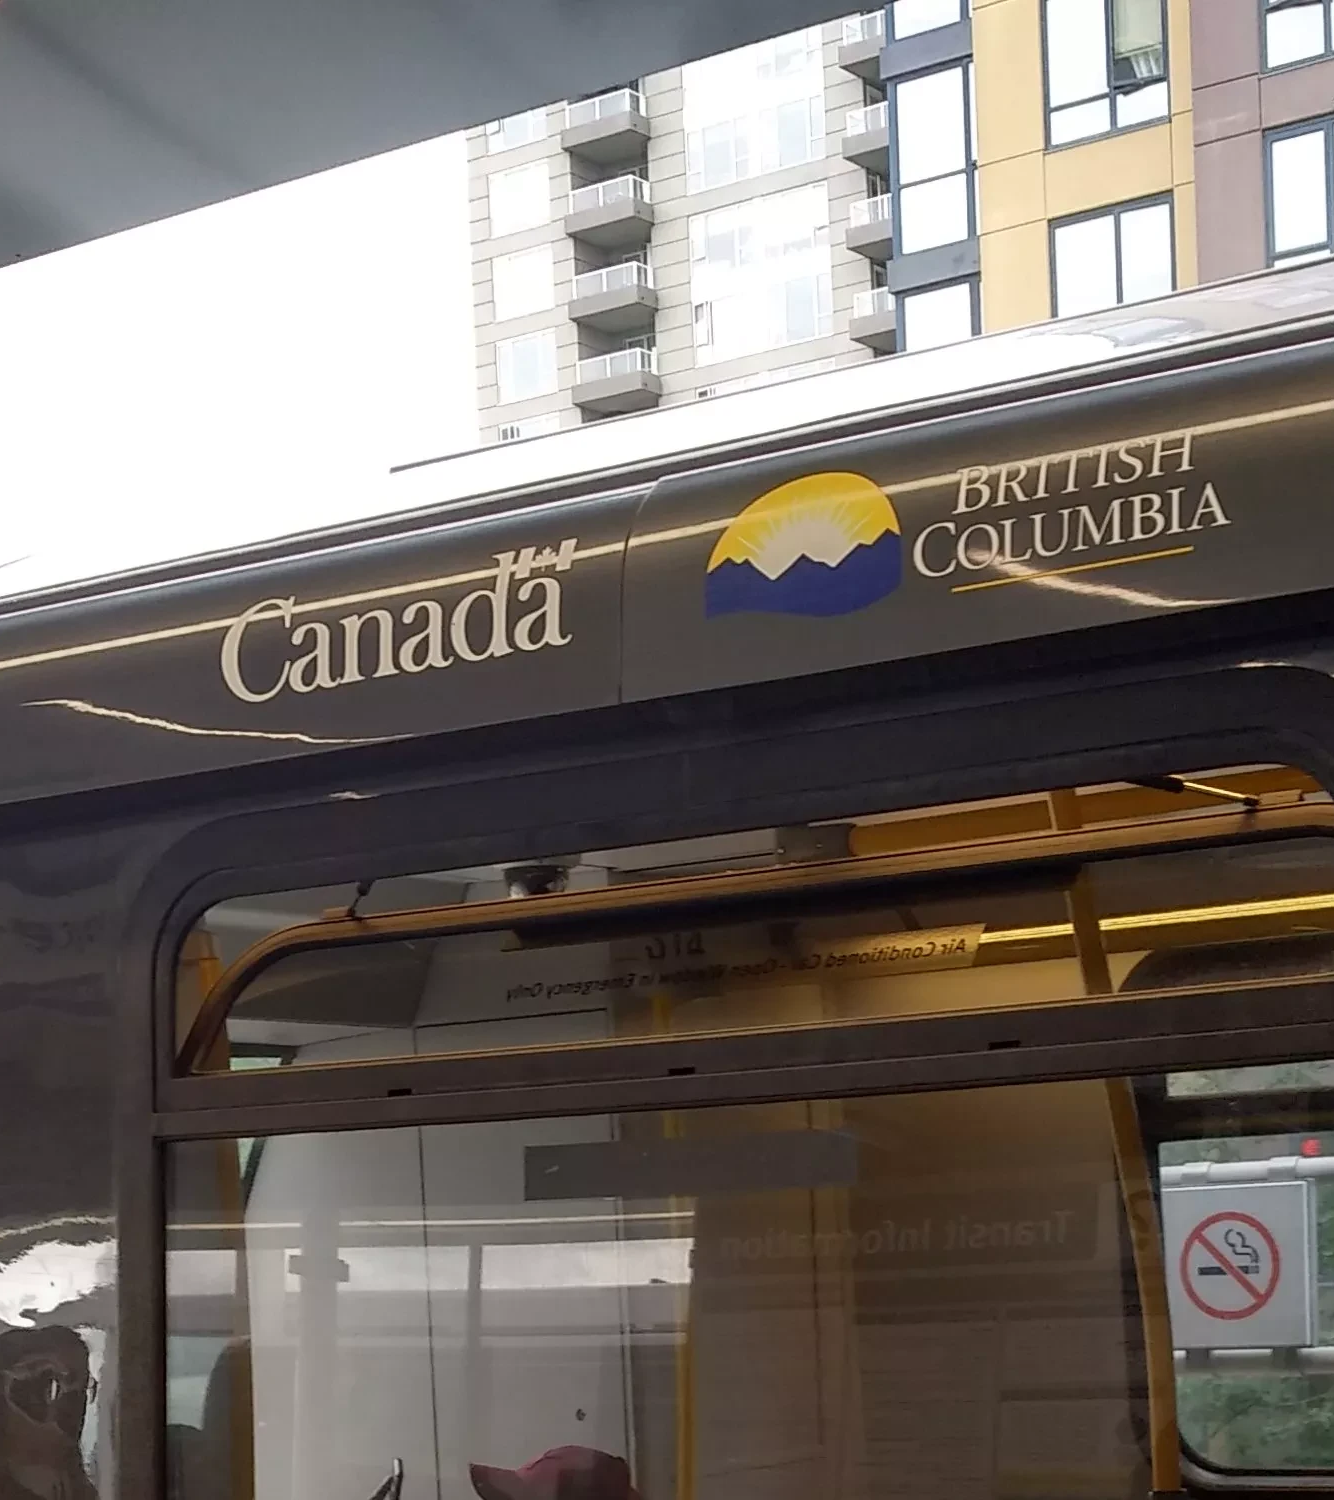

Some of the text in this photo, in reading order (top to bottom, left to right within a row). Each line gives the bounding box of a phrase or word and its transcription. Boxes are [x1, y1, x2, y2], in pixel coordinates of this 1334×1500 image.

[952, 430, 1195, 516] BRITISH
[912, 480, 1232, 578] COLUMBIA
[220, 543, 575, 703] Canada
